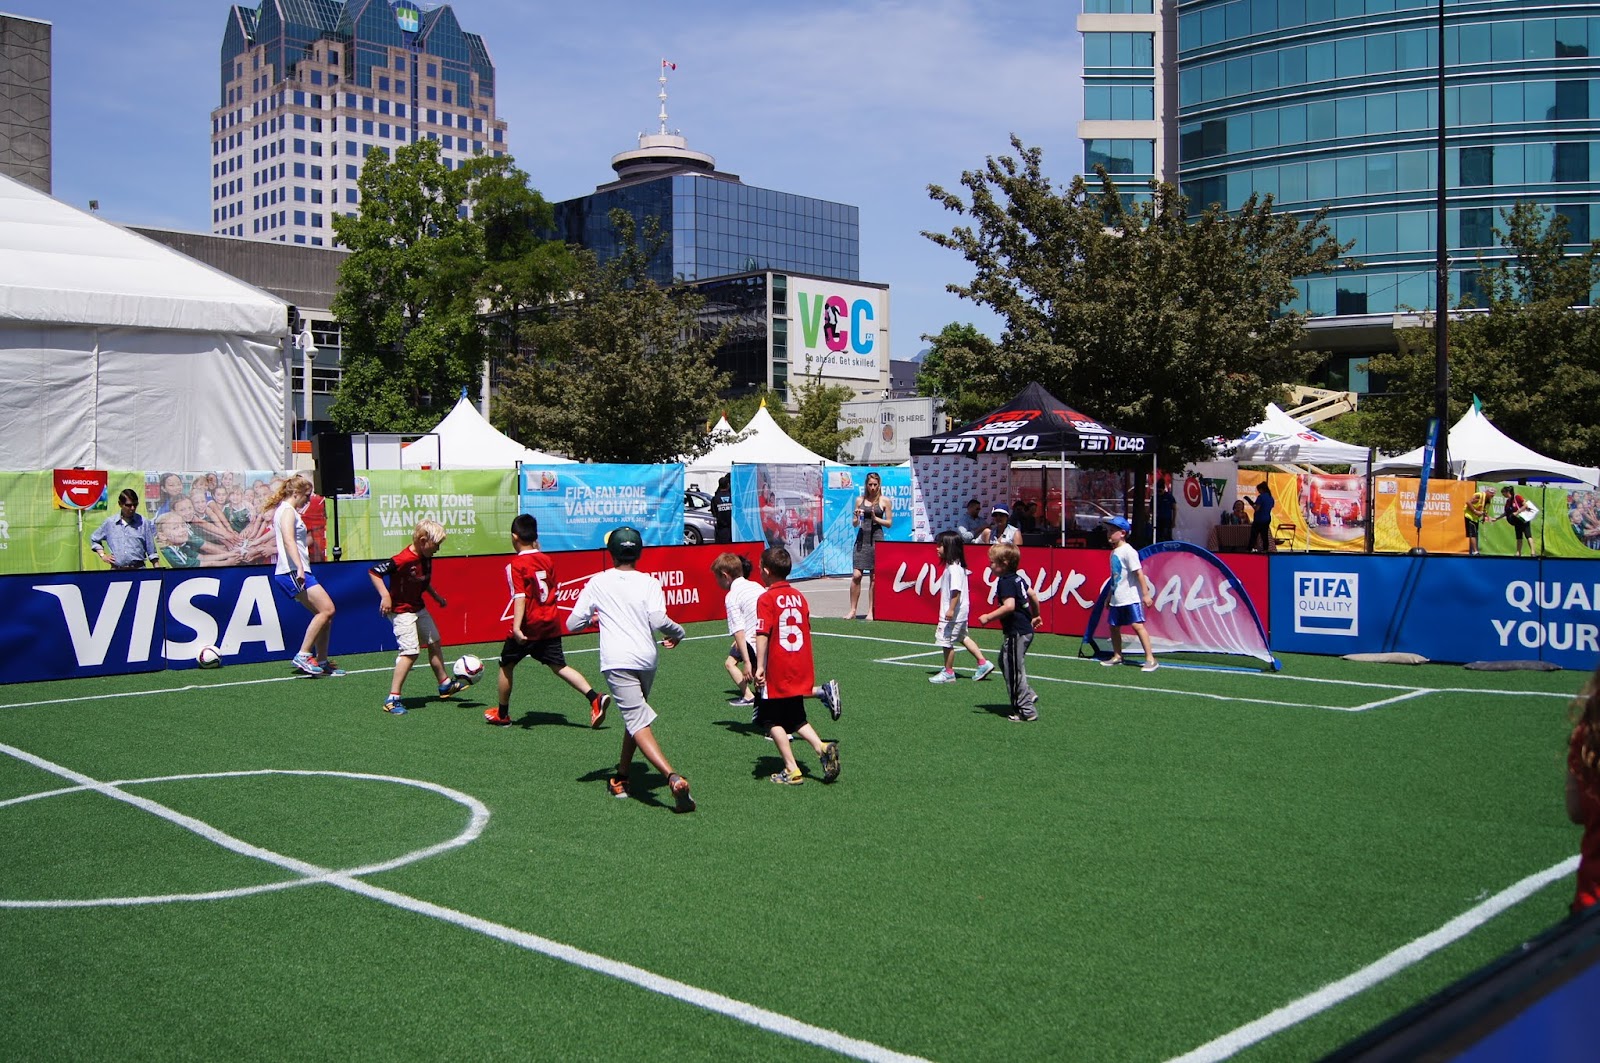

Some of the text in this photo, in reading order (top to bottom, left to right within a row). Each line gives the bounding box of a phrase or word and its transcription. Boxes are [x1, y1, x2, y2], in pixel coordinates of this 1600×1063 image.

[797, 292, 874, 355] VCC
[840, 356, 851, 366] Get
[852, 358, 876, 368] skilled.
[846, 417, 877, 425] ORIGINAL
[881, 412, 896, 424] Lite
[985, 435, 1040, 452] 1040
[565, 485, 646, 500] FIFA FAN ZONE
[899, 485, 912, 496] ZO
[1400, 491, 1416, 500] FIFA
[1432, 492, 1450, 501] ZONE
[380, 494, 474, 509] FIFA FAN ZONE
[565, 500, 648, 517] VANCOUVER
[1400, 500, 1451, 511] VANOUVER
[535, 570, 549, 603] 5
[892, 561, 951, 596] LIV
[662, 587, 700, 606] NADA
[1299, 577, 1352, 599] FIFA
[776, 594, 803, 608] CAN
[1298, 600, 1352, 612] QUALITY
[32, 574, 286, 667] VISA
[778, 607, 804, 652] 6
[1491, 619, 1600, 652] YOUR
